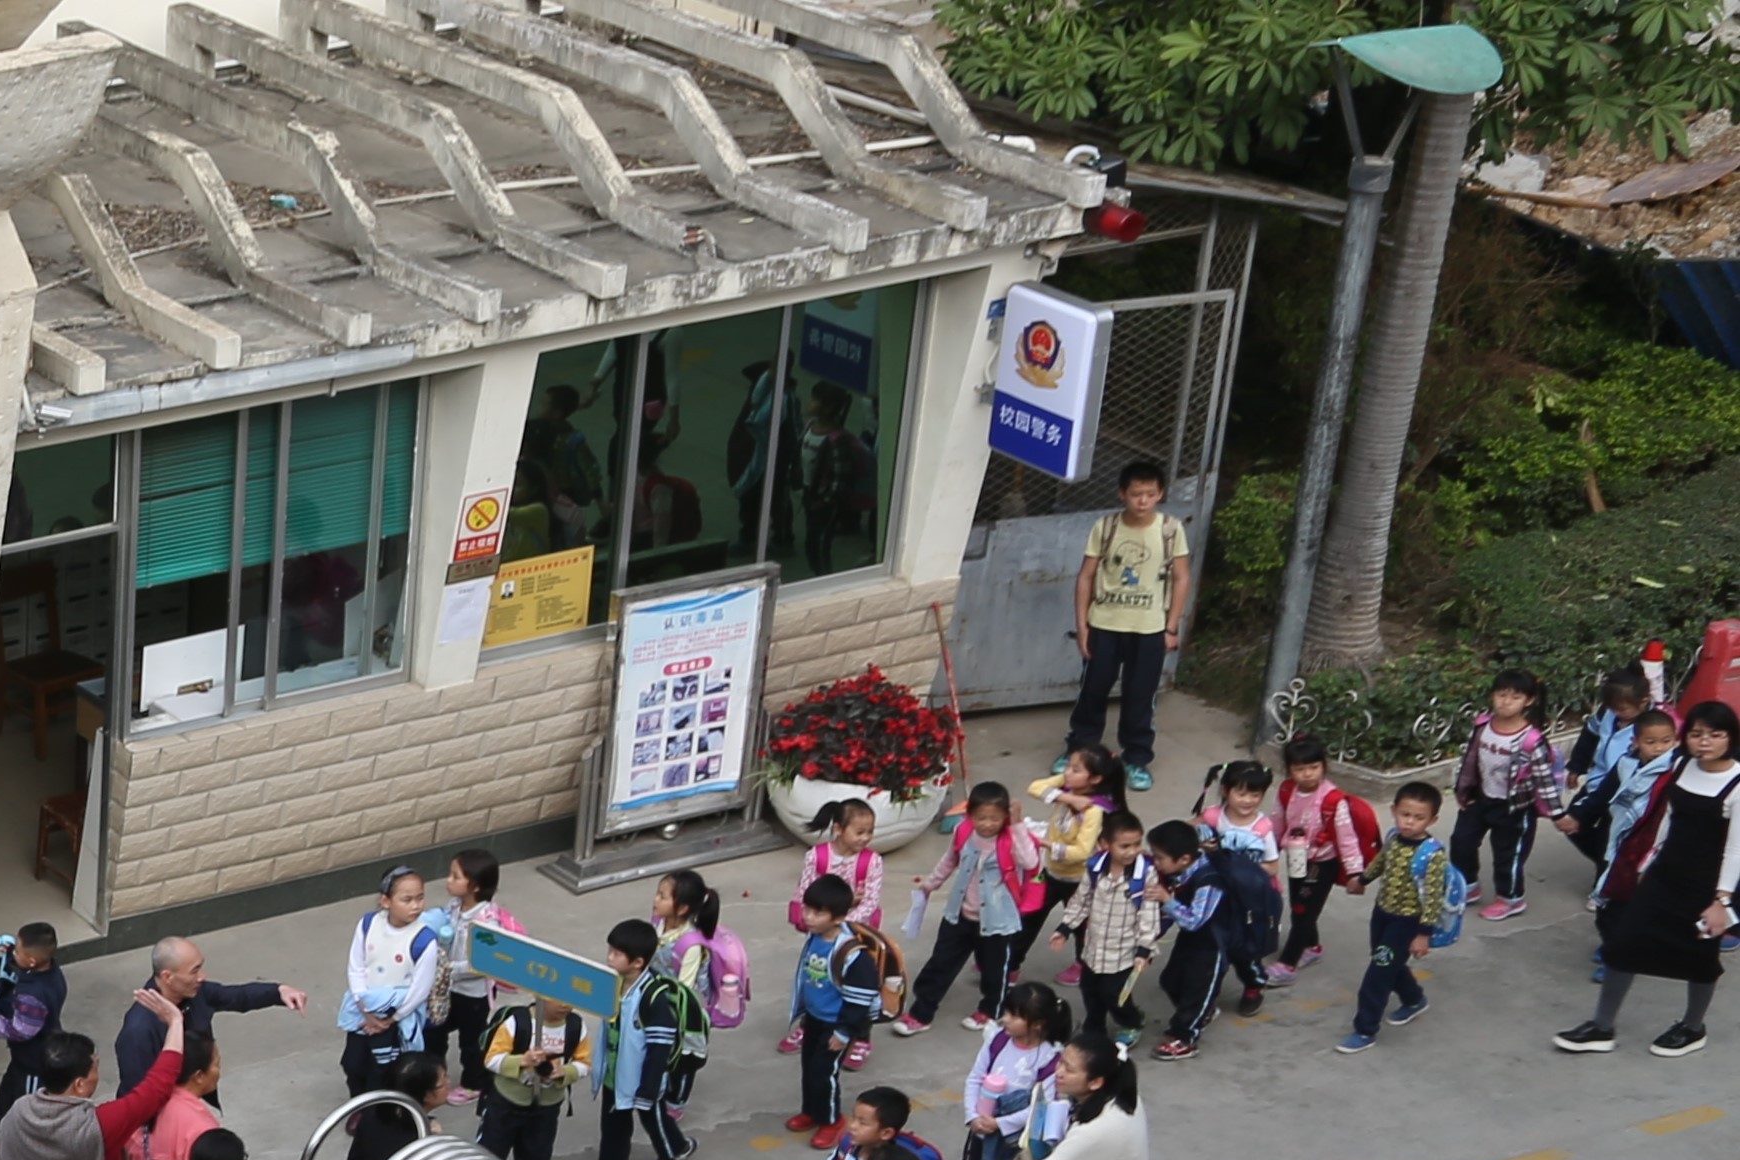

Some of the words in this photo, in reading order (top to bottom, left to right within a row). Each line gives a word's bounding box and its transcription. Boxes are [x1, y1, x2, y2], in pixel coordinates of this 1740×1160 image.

[998, 402, 1064, 448] 校园警务
[663, 607, 725, 630] 认识毒品
